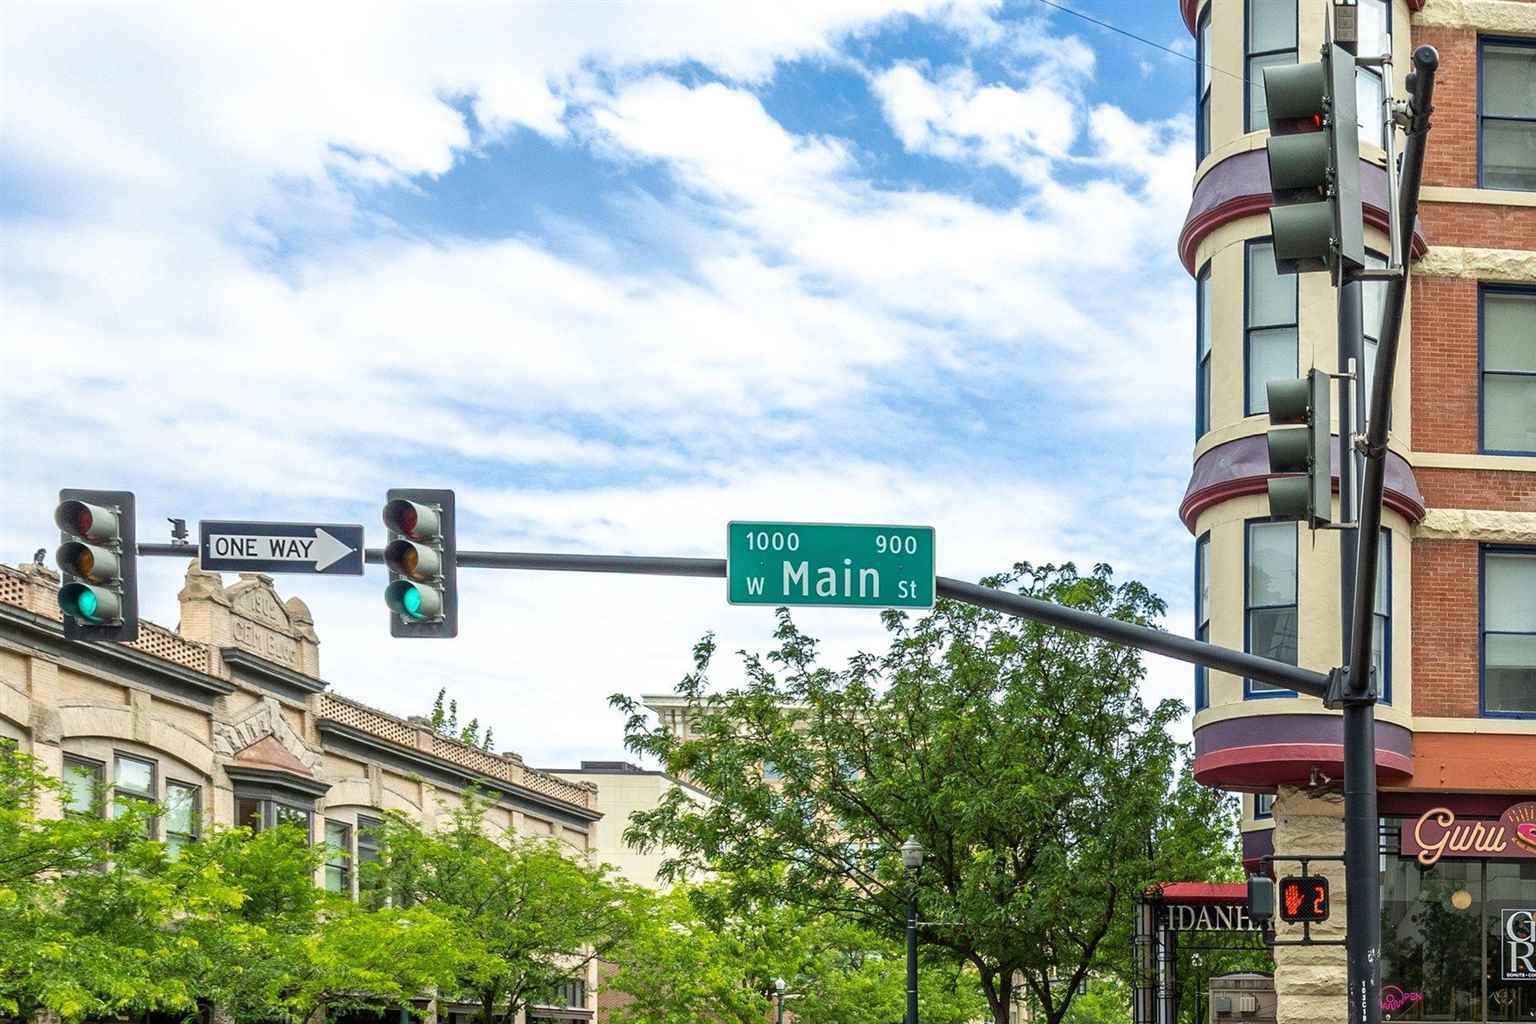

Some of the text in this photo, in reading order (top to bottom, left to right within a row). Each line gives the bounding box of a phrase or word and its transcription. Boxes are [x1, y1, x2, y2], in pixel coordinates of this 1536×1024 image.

[215, 537, 314, 559] ONE WAY
[746, 531, 800, 551] 1000
[875, 535, 918, 555] 900
[746, 558, 917, 600] W Main St
[1414, 807, 1507, 865] Guru
[1313, 886, 1326, 914] 2
